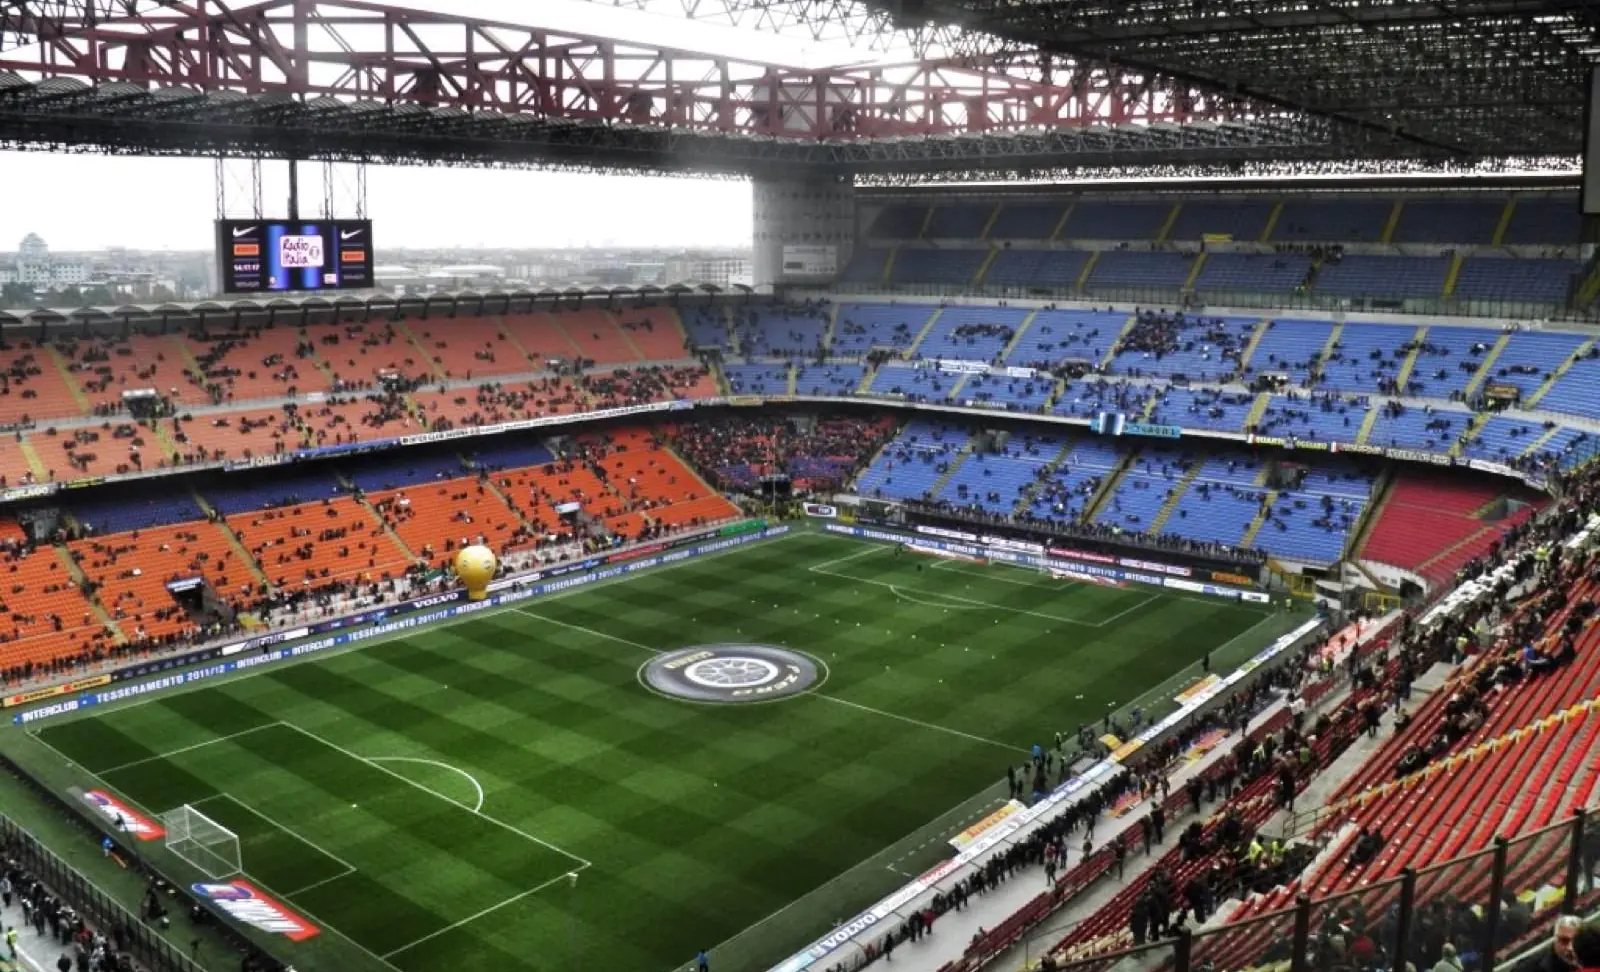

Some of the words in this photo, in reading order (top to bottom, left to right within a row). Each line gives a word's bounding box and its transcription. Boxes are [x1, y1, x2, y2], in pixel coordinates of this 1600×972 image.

[282, 238, 309, 251] Radio
[284, 252, 309, 265] Italia
[413, 592, 459, 609] VOLVO
[22, 699, 79, 722] INTERCLUB
[96, 672, 184, 704] TESSERAMENTO
[187, 663, 226, 681] 2011/12
[236, 651, 282, 669] INTERCLUB
[291, 637, 335, 656] INTERCLUB
[348, 617, 416, 641] TESSERAMENTO
[820, 912, 877, 951] VOLVO
